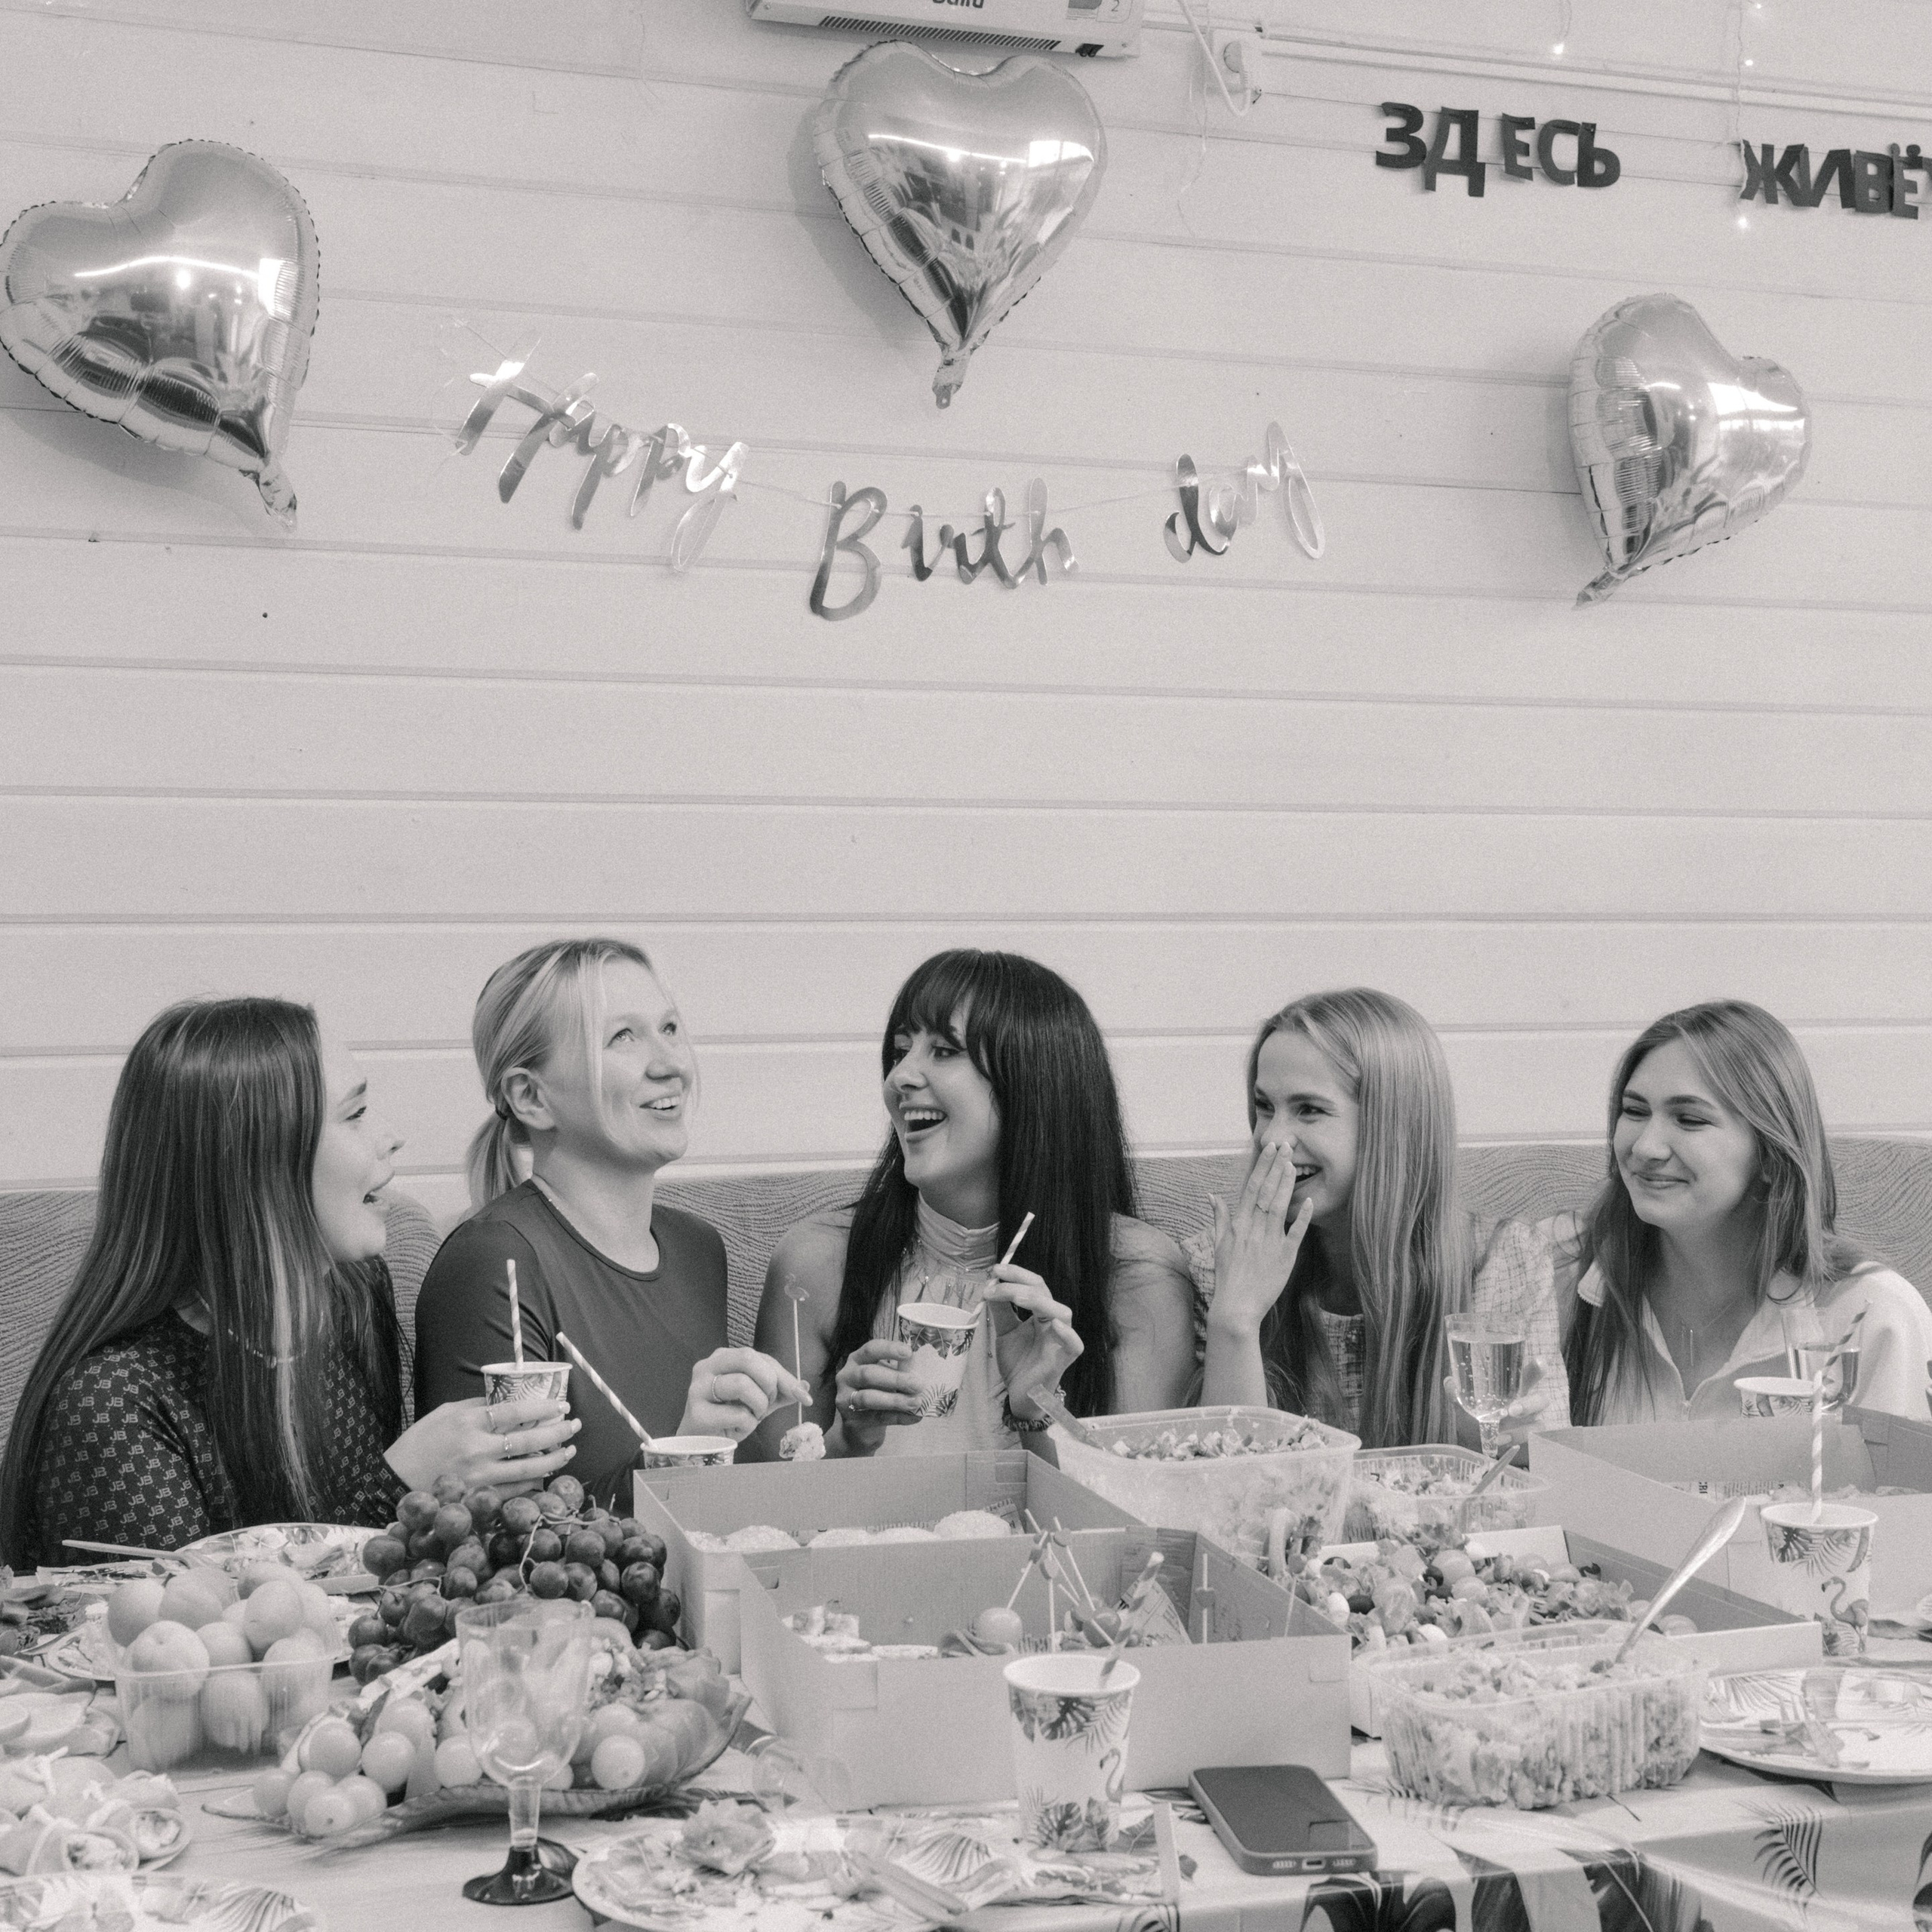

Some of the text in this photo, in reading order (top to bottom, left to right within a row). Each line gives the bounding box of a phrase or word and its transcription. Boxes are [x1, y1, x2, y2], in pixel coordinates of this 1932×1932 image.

[1376, 102, 1620, 198] ЗДЕСЬ
[456, 359, 1324, 621] Happy Birth day
[103, 1354, 121, 1363] JB
[84, 1365, 102, 1375] JB
[112, 1369, 129, 1378] JB
[67, 1380, 84, 1391] JB
[94, 1380, 112, 1389] JB
[123, 1383, 140, 1395] JB
[78, 1396, 95, 1408] JB
[106, 1397, 124, 1407] JB
[67, 1414, 82, 1426] JB
[92, 1413, 110, 1424] JB
[122, 1414, 139, 1424] JB
[82, 1432, 98, 1444] JB
[109, 1430, 128, 1441] JB
[100, 1447, 117, 1458] JB
[128, 1444, 144, 1456] JB
[75, 1450, 89, 1463] JB
[118, 1463, 135, 1474] JB
[146, 1458, 161, 1470] JB
[67, 1472, 82, 1484] JB
[91, 1466, 107, 1478] JB
[162, 1469, 177, 1481] JB
[109, 1481, 126, 1492] JB
[137, 1475, 153, 1487] JB
[83, 1485, 98, 1497] JB
[155, 1487, 172, 1499] JB
[100, 1500, 118, 1512] JB
[128, 1494, 146, 1506] JB
[174, 1497, 189, 1509] JB
[148, 1505, 165, 1517] JB
[119, 1512, 137, 1524] JB
[167, 1516, 184, 1528] JB
[94, 1520, 109, 1532] JB
[140, 1524, 157, 1537] JB
[186, 1524, 201, 1537] JB
[159, 1534, 177, 1546] JB
